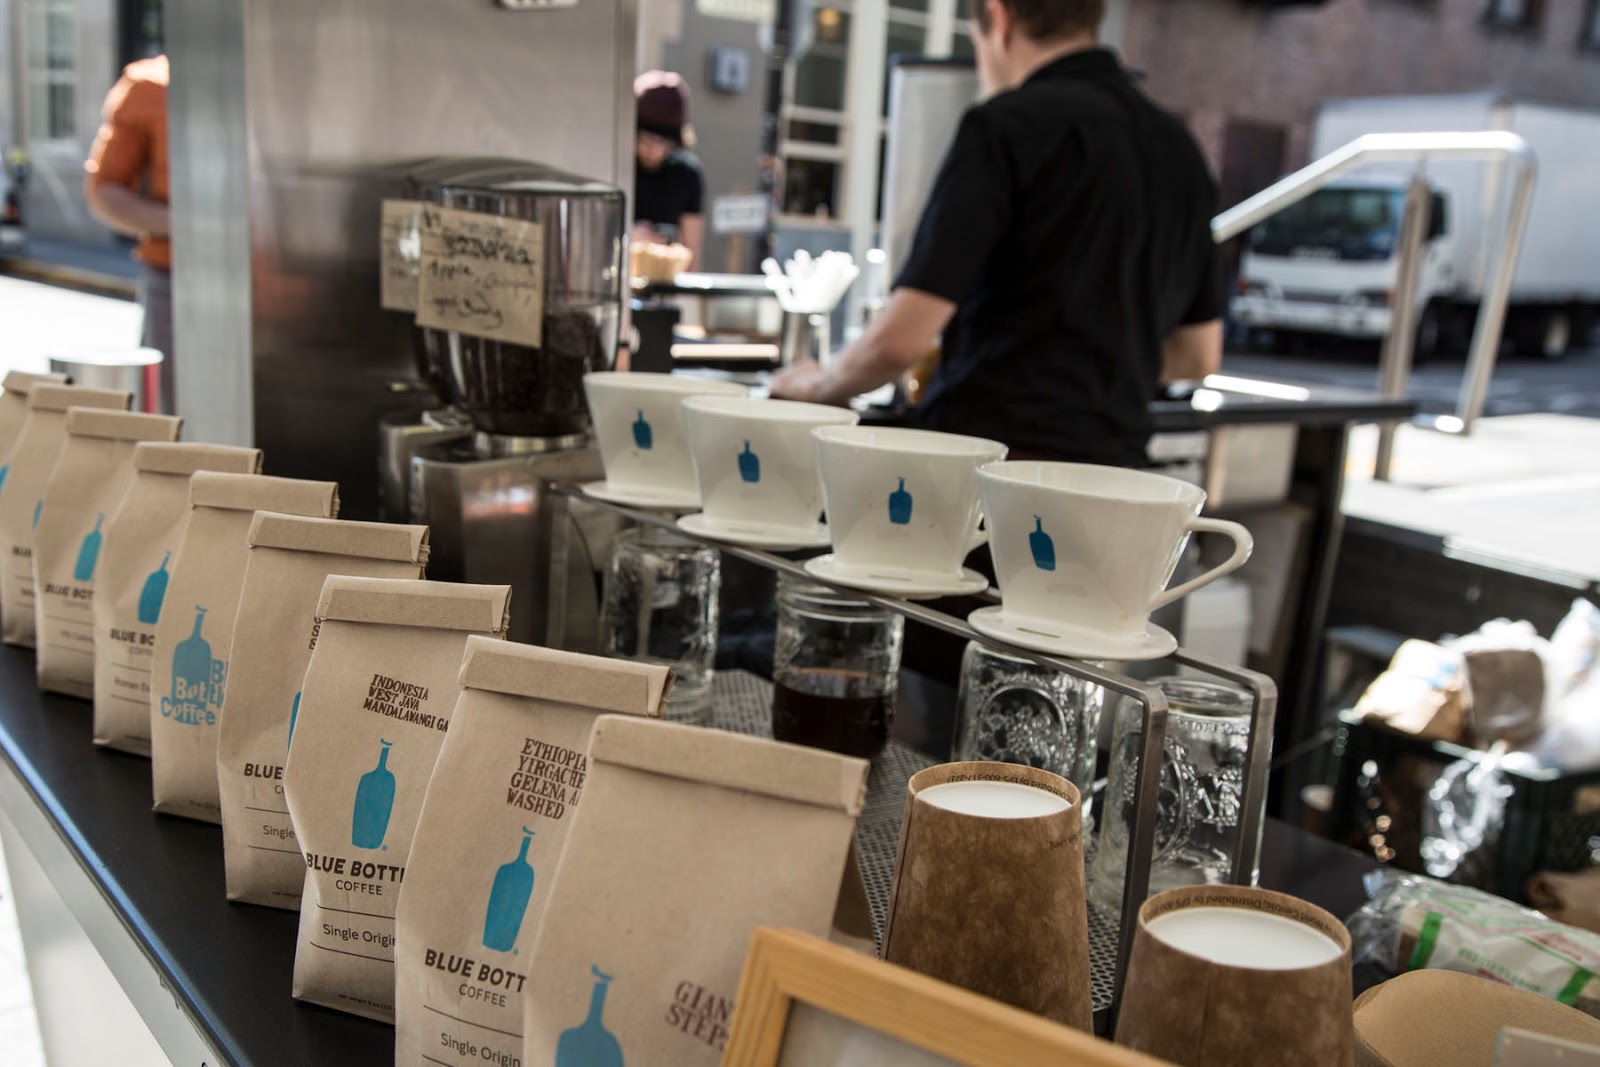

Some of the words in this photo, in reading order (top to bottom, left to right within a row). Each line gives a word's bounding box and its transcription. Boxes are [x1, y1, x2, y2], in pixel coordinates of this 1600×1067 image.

[368, 685, 399, 704] WEST
[398, 695, 420, 711] JAVA
[370, 673, 429, 701] INDONESIA
[161, 696, 217, 726] Coffee
[362, 698, 437, 729] MANDALAWANGI
[436, 717, 450, 732] GA
[520, 737, 587, 772] ETHIOPIA
[243, 762, 283, 780] BLUE
[510, 771, 566, 802] GELENA
[517, 754, 587, 790] YIRGACHE
[506, 787, 565, 820] WASHED
[1019, 776, 1030, 787] by
[1030, 779, 1067, 800] Distributed
[262, 824, 296, 840] Single
[305, 851, 346, 875] BLUE
[350, 860, 406, 883] BOTT
[335, 879, 383, 896] COFFEE
[322, 923, 359, 941] Single
[424, 948, 475, 978] BLUE
[477, 963, 527, 993] BOTT
[458, 983, 507, 1007] COFFEE
[674, 979, 735, 1022] GIAN
[664, 1003, 729, 1052] STEP
[440, 1032, 477, 1056] Single
[480, 1046, 521, 1067] Origin
